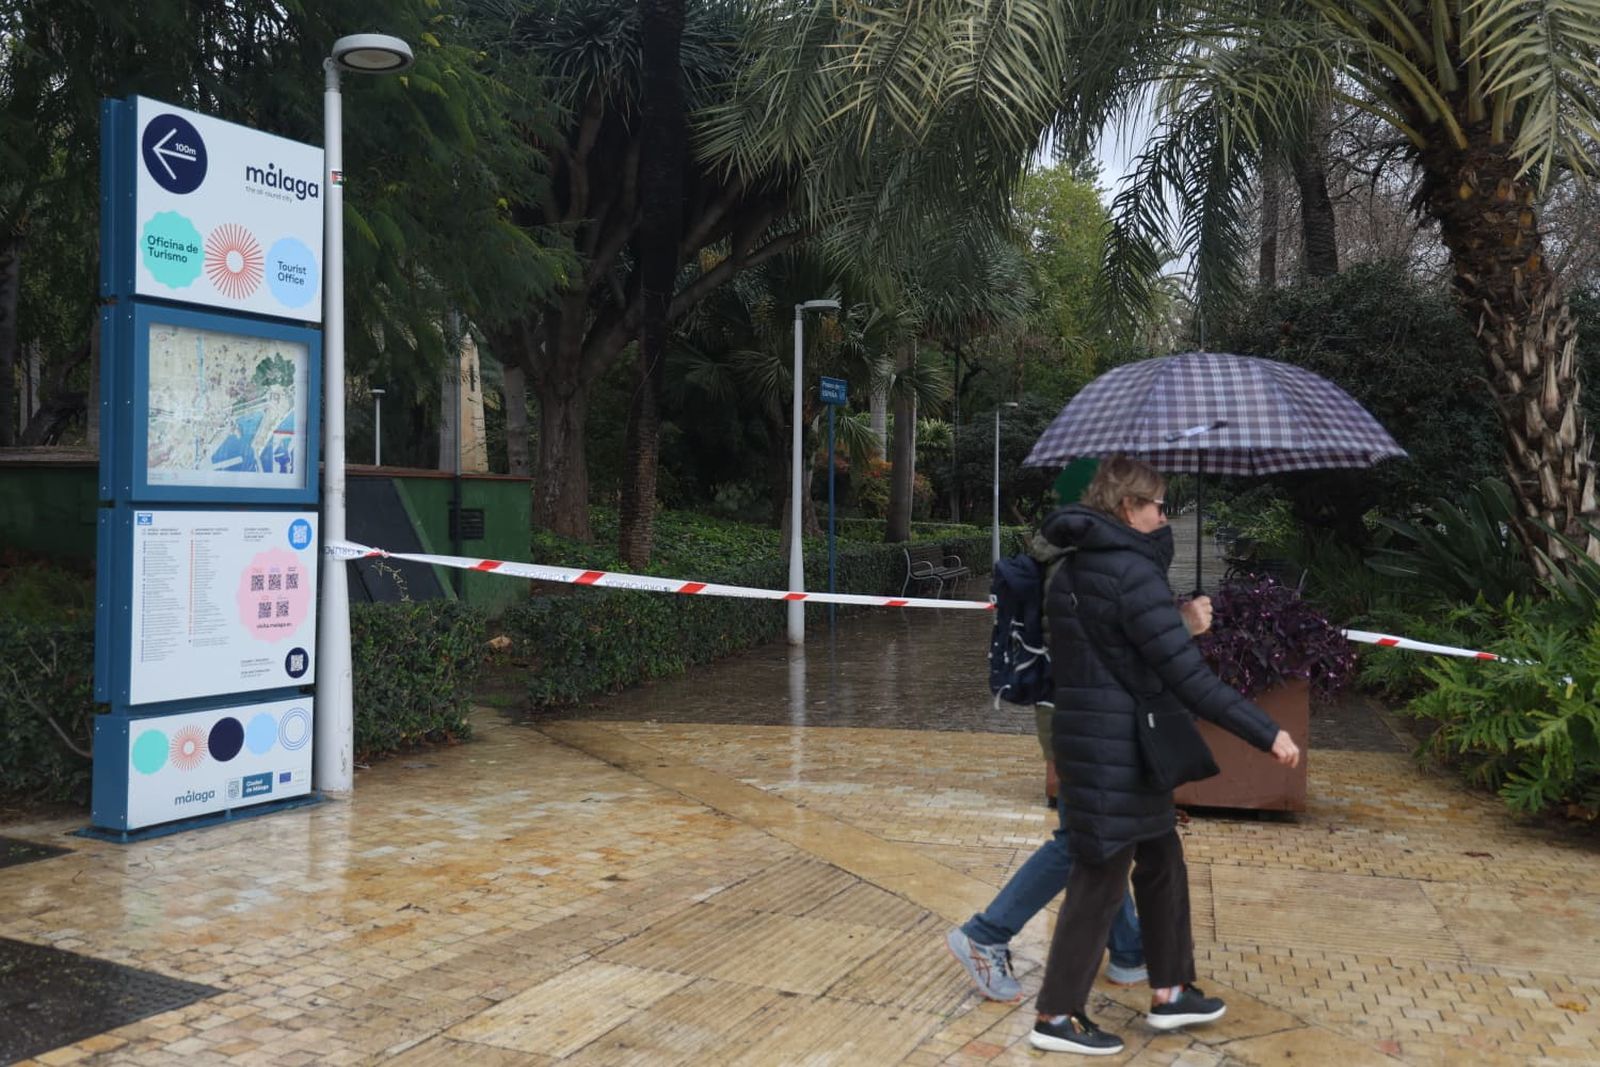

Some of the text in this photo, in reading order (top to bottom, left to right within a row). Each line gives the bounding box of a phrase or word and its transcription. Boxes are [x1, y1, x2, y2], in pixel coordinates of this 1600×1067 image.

[175, 143, 197, 156] 100m
[147, 234, 199, 254] Oficina de
[147, 246, 188, 263] Turismo
[277, 260, 307, 275] Tourist
[277, 271, 305, 286] Office
